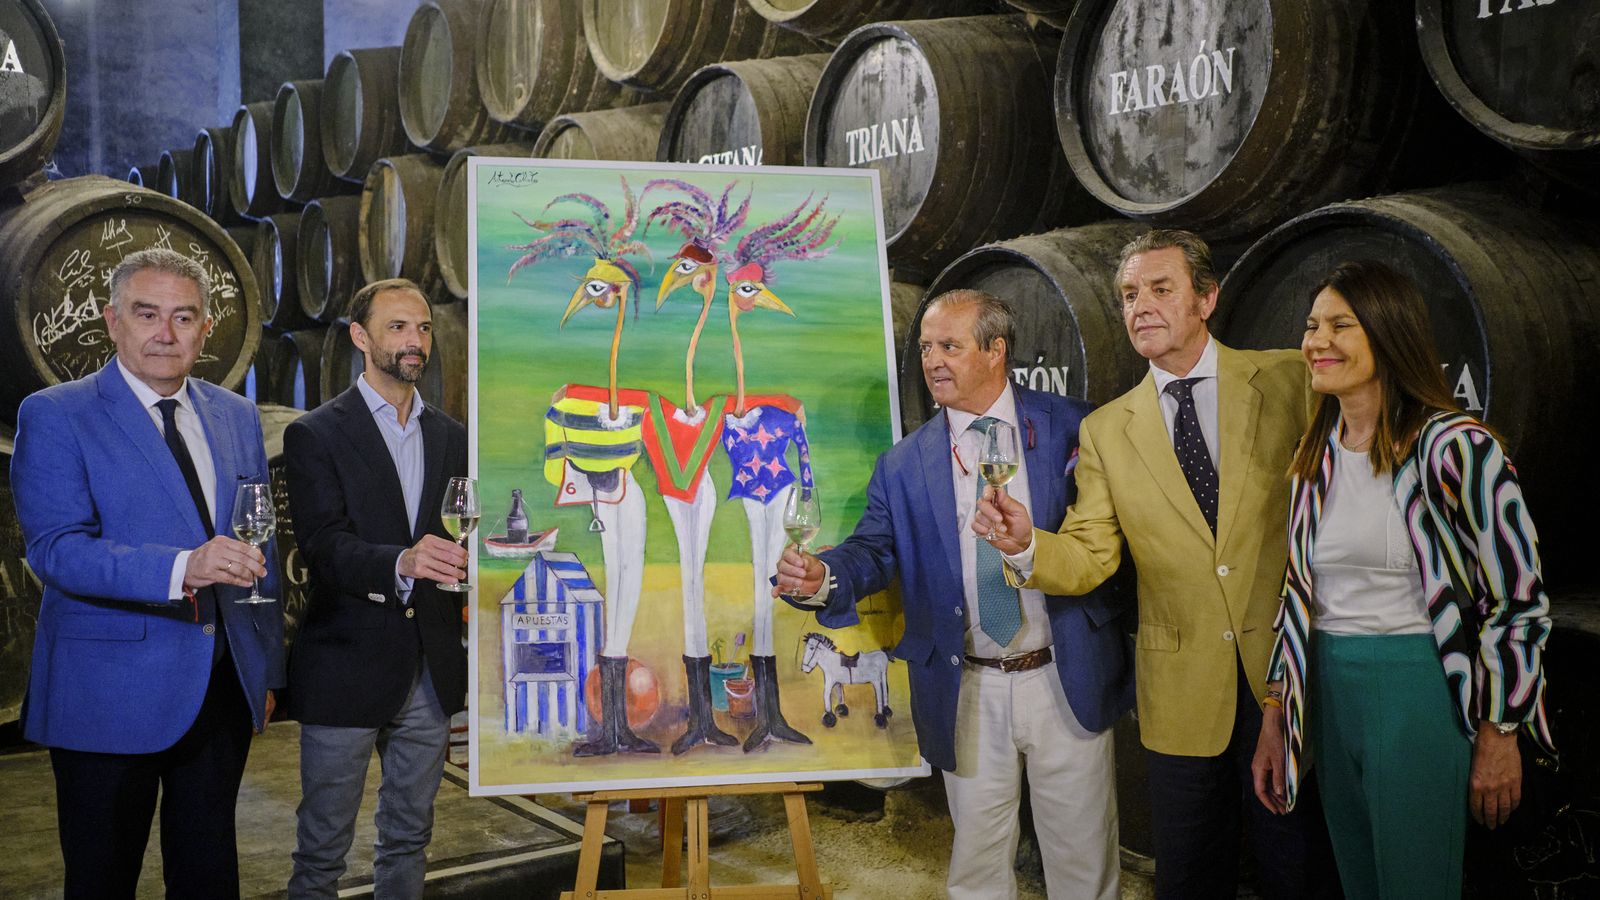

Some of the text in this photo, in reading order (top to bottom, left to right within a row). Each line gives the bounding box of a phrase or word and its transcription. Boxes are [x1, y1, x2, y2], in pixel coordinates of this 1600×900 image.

[1108, 39, 1236, 116] FARAÓN
[845, 114, 925, 167] TRIANA
[565, 481, 577, 496] 6
[516, 615, 569, 626] APUESTAS
